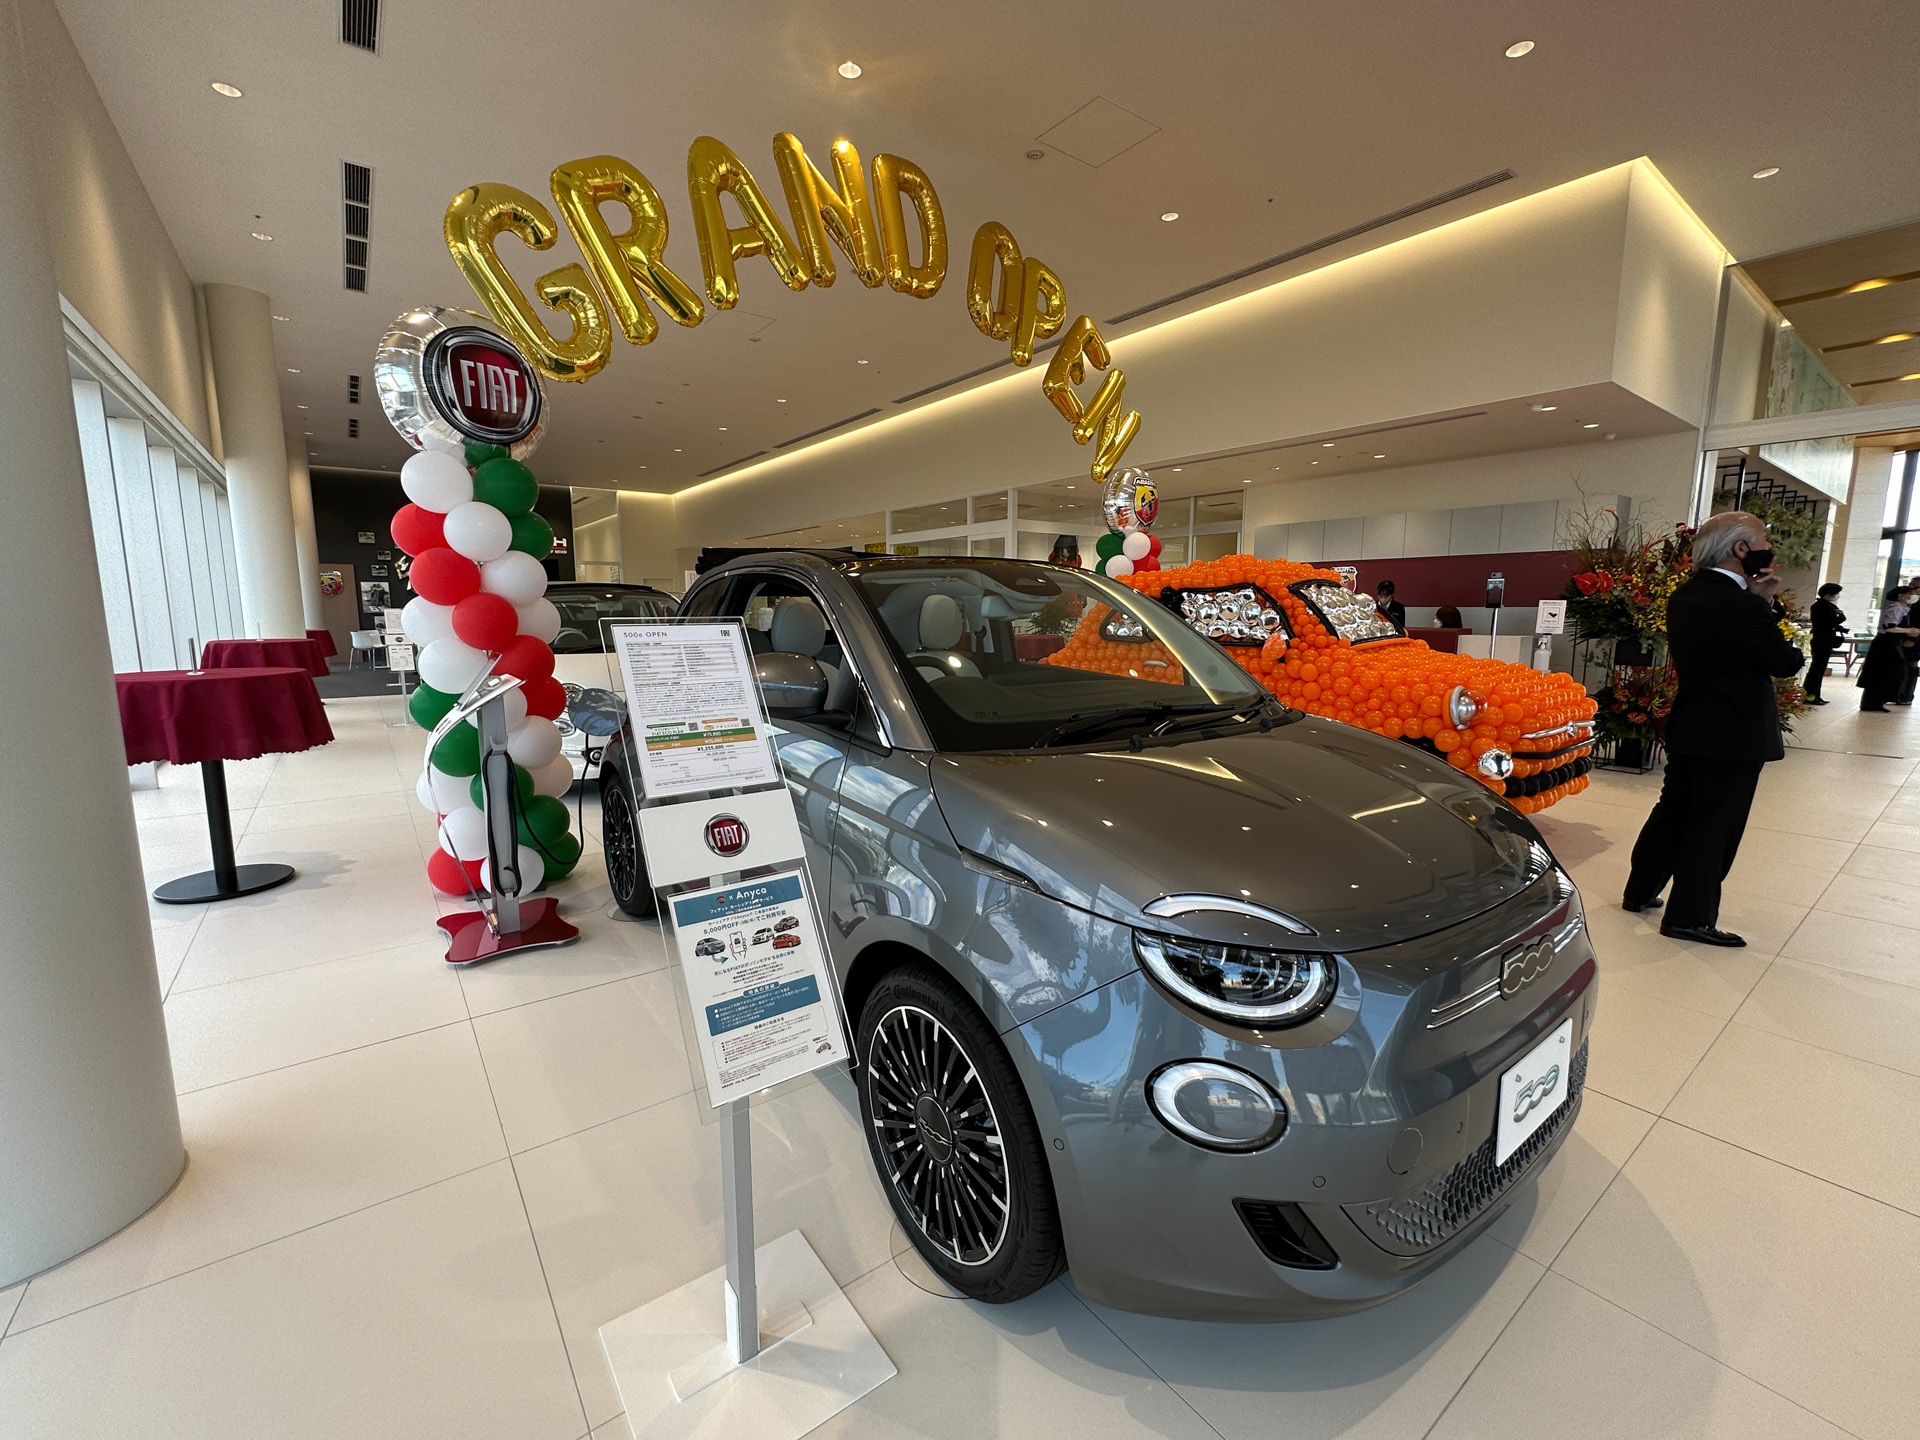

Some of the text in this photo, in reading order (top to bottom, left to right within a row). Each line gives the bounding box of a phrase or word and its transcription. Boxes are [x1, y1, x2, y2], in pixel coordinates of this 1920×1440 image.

[443, 131, 1142, 484] GRAND OPEN
[460, 359, 519, 414] FIAT
[714, 824, 740, 848] FIAT
[736, 887, 767, 900] Anyca
[1513, 1064, 1560, 1123] 500
